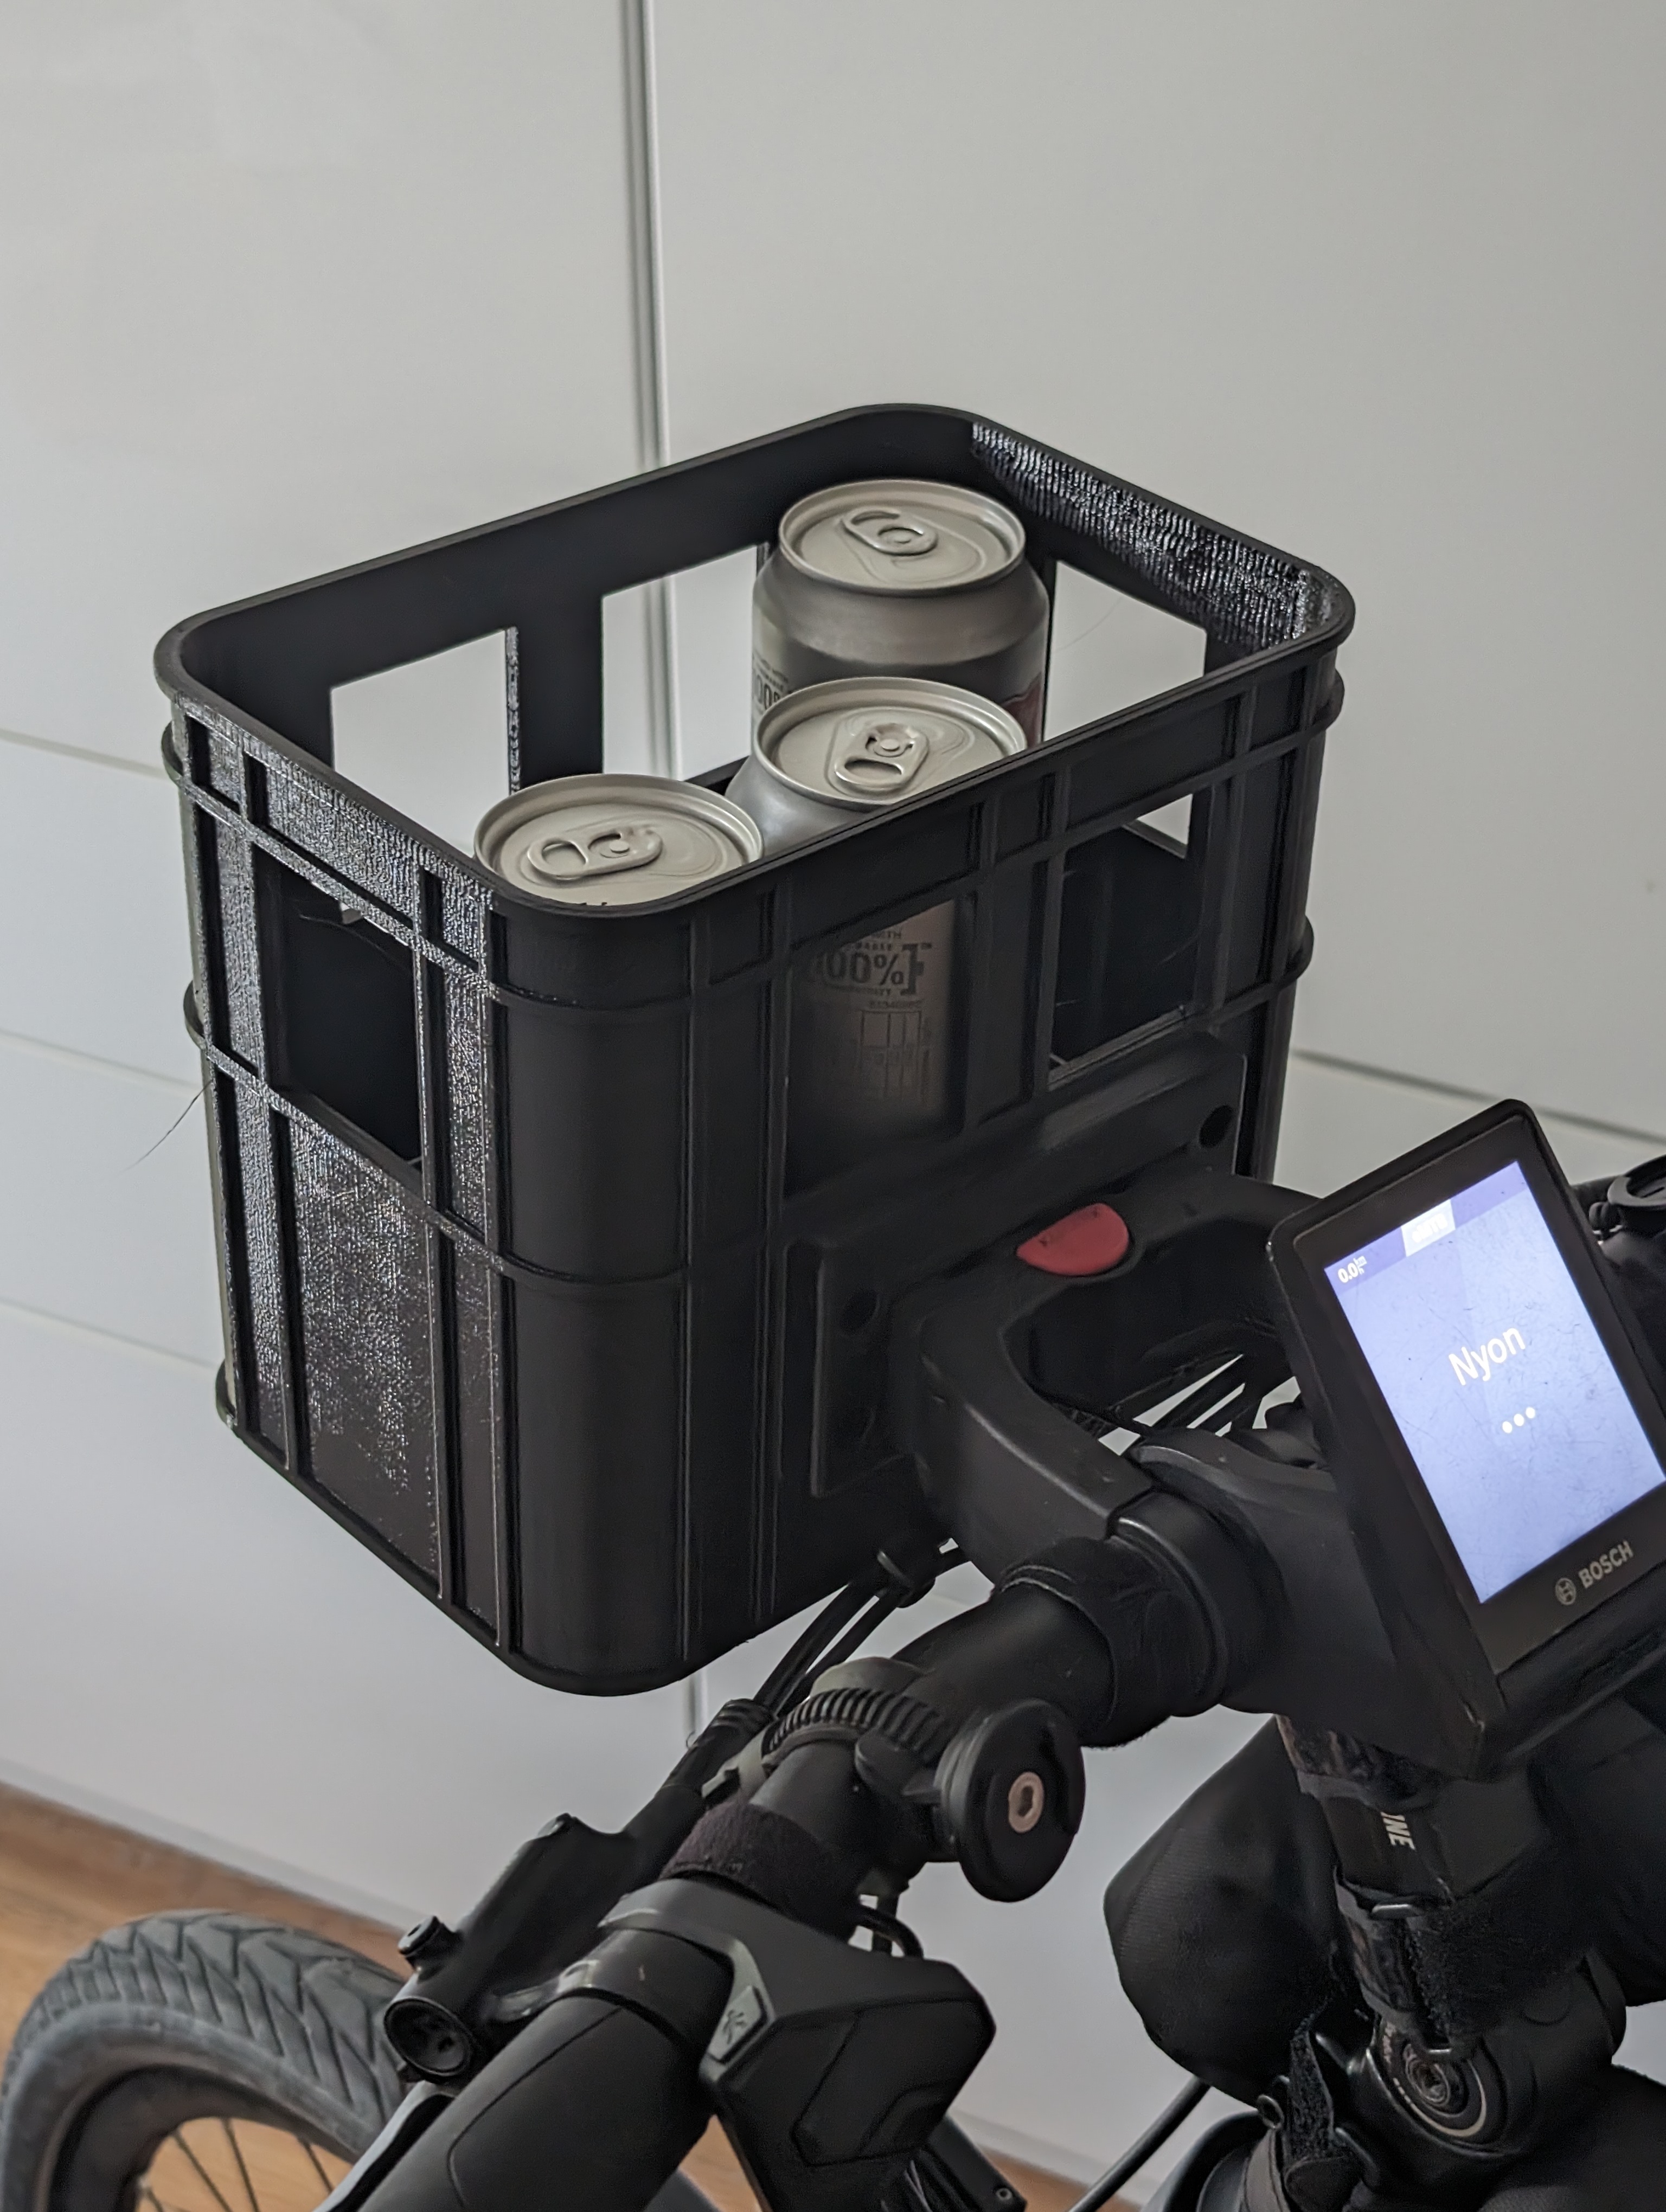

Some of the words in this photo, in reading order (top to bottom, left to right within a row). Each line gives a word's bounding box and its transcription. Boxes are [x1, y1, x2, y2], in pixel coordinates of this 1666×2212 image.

[1337, 1262, 1359, 1283] 0.0
[1447, 1327, 1526, 1386] Nyon
[1578, 1540, 1634, 1589] BOSCH
